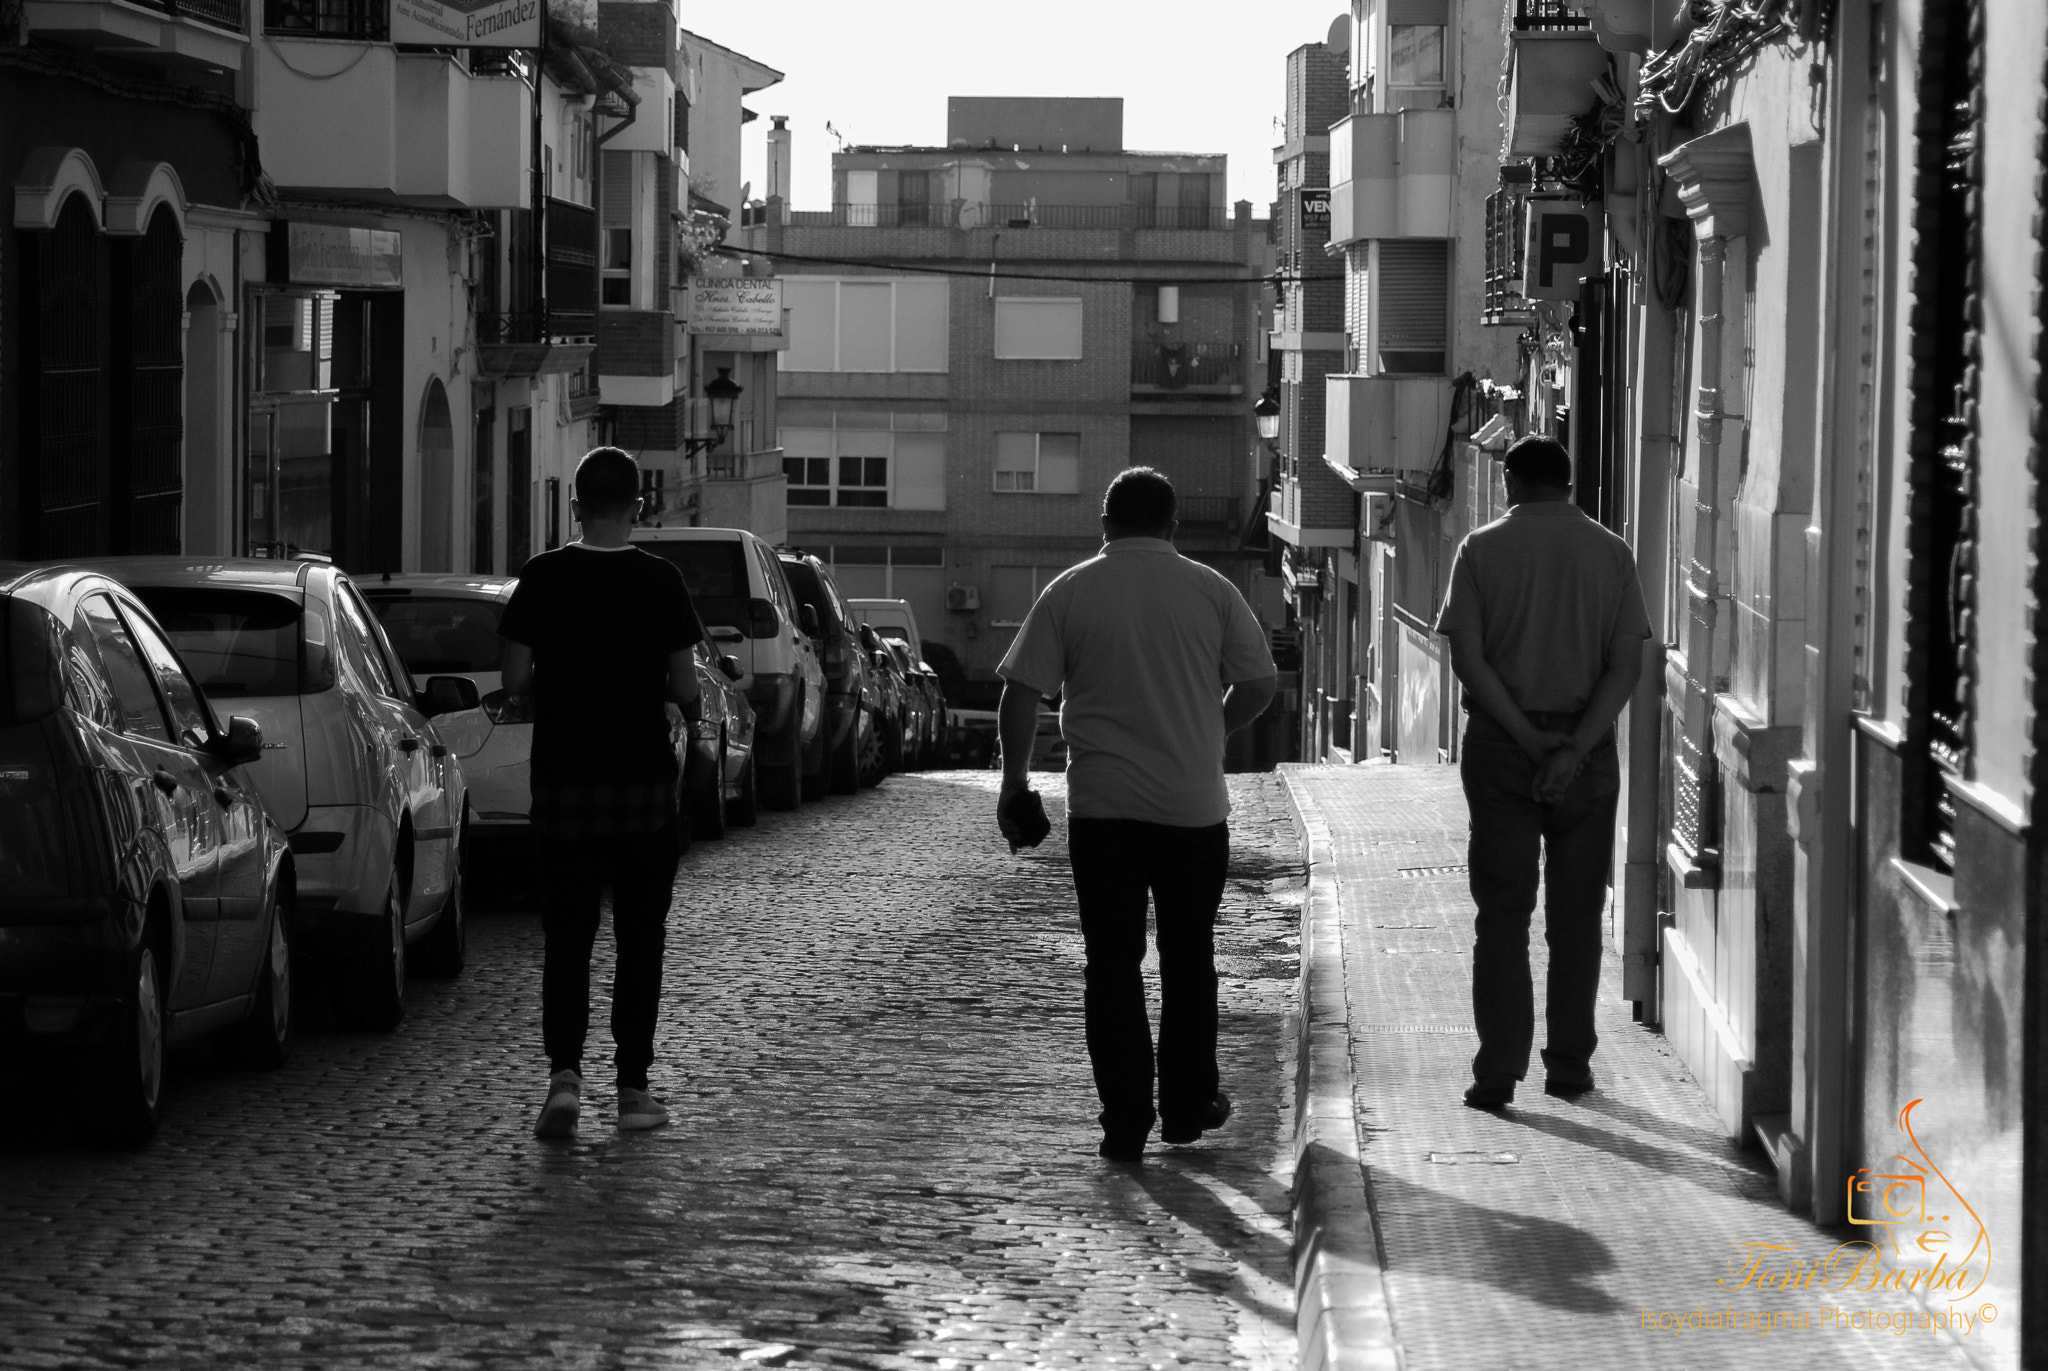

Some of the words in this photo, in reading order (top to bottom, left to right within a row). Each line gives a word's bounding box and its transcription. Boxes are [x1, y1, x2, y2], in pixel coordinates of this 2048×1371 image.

[466, 0, 537, 41] Fernández
[1539, 213, 1589, 287] P
[735, 278, 774, 290] DENTAL
[736, 291, 775, 304] Cabello
